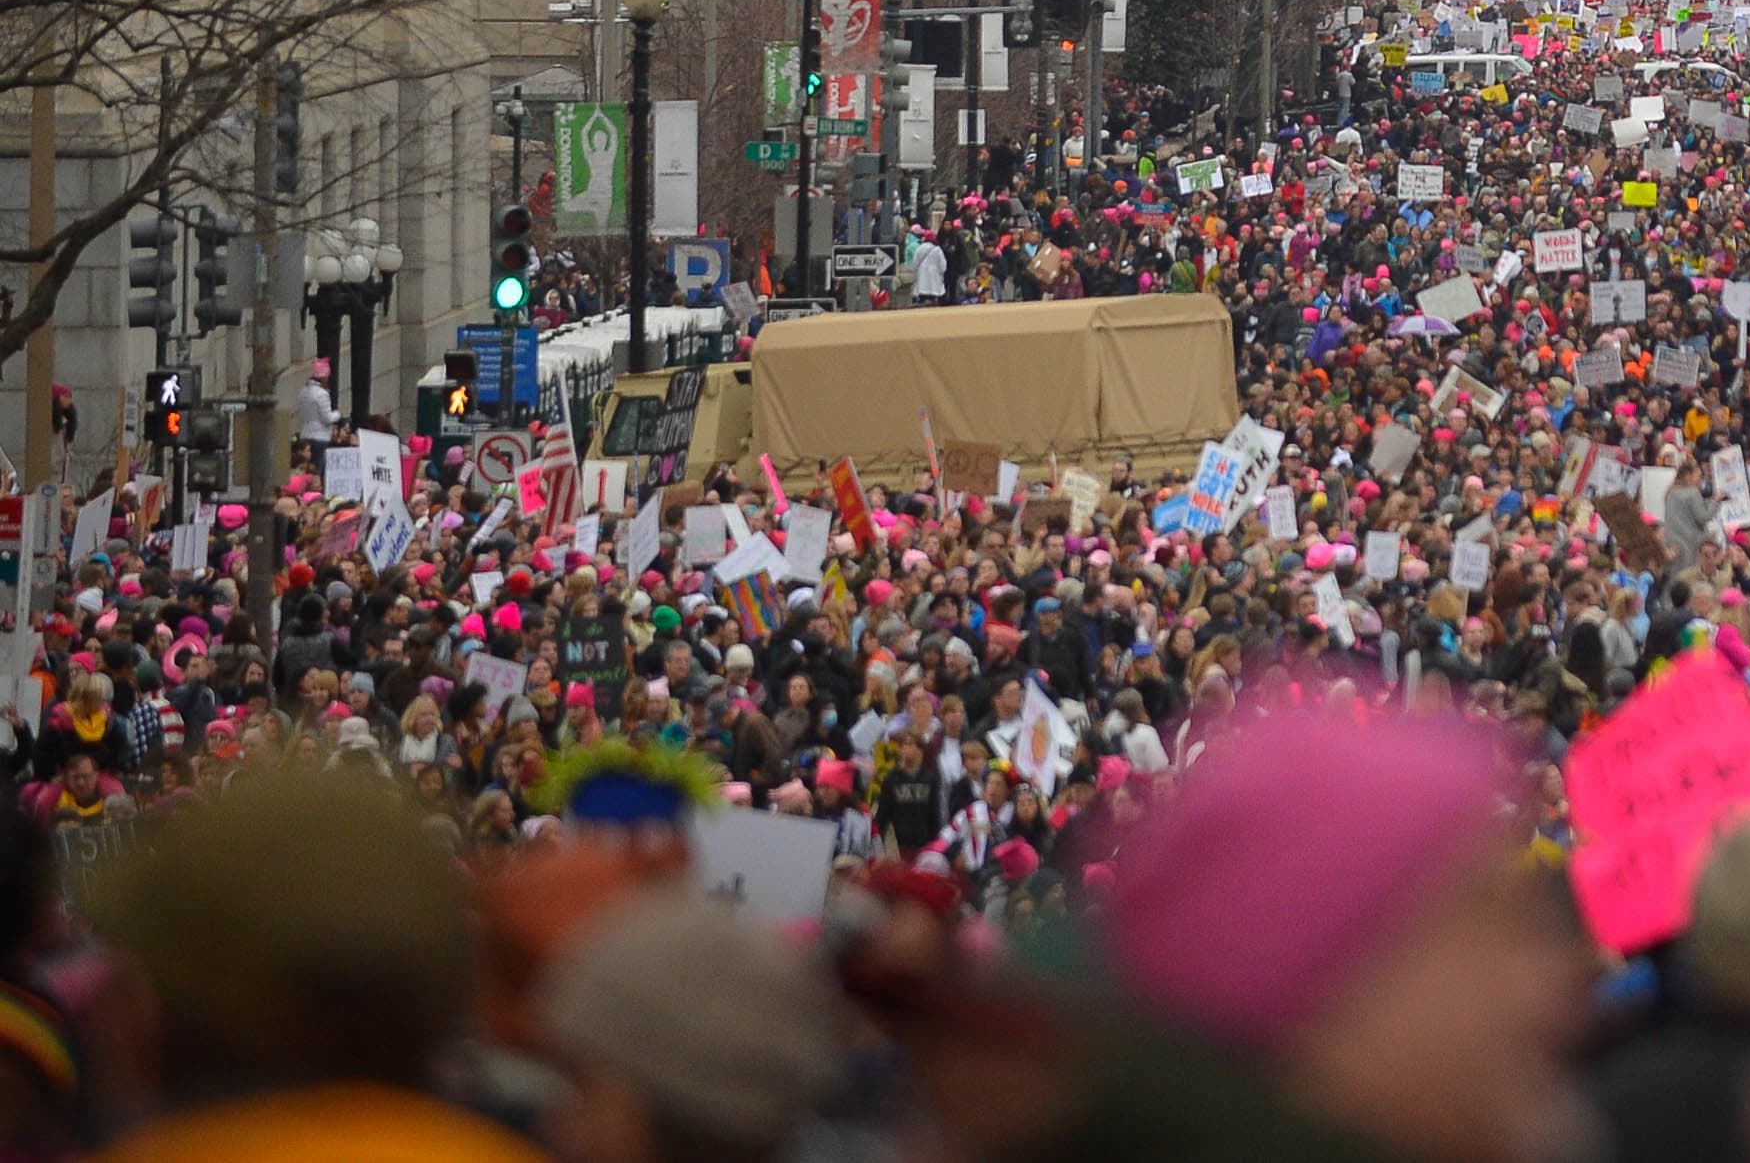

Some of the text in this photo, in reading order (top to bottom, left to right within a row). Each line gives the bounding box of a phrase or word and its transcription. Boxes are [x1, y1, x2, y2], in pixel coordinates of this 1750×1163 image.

[760, 144, 771, 159] D
[1544, 233, 1576, 247] WORDS
[837, 257, 885, 267] ONE WAY
[1540, 249, 1577, 263] MATTER
[674, 244, 722, 298] P
[371, 464, 393, 485] HATE
[566, 640, 609, 662] NOT
